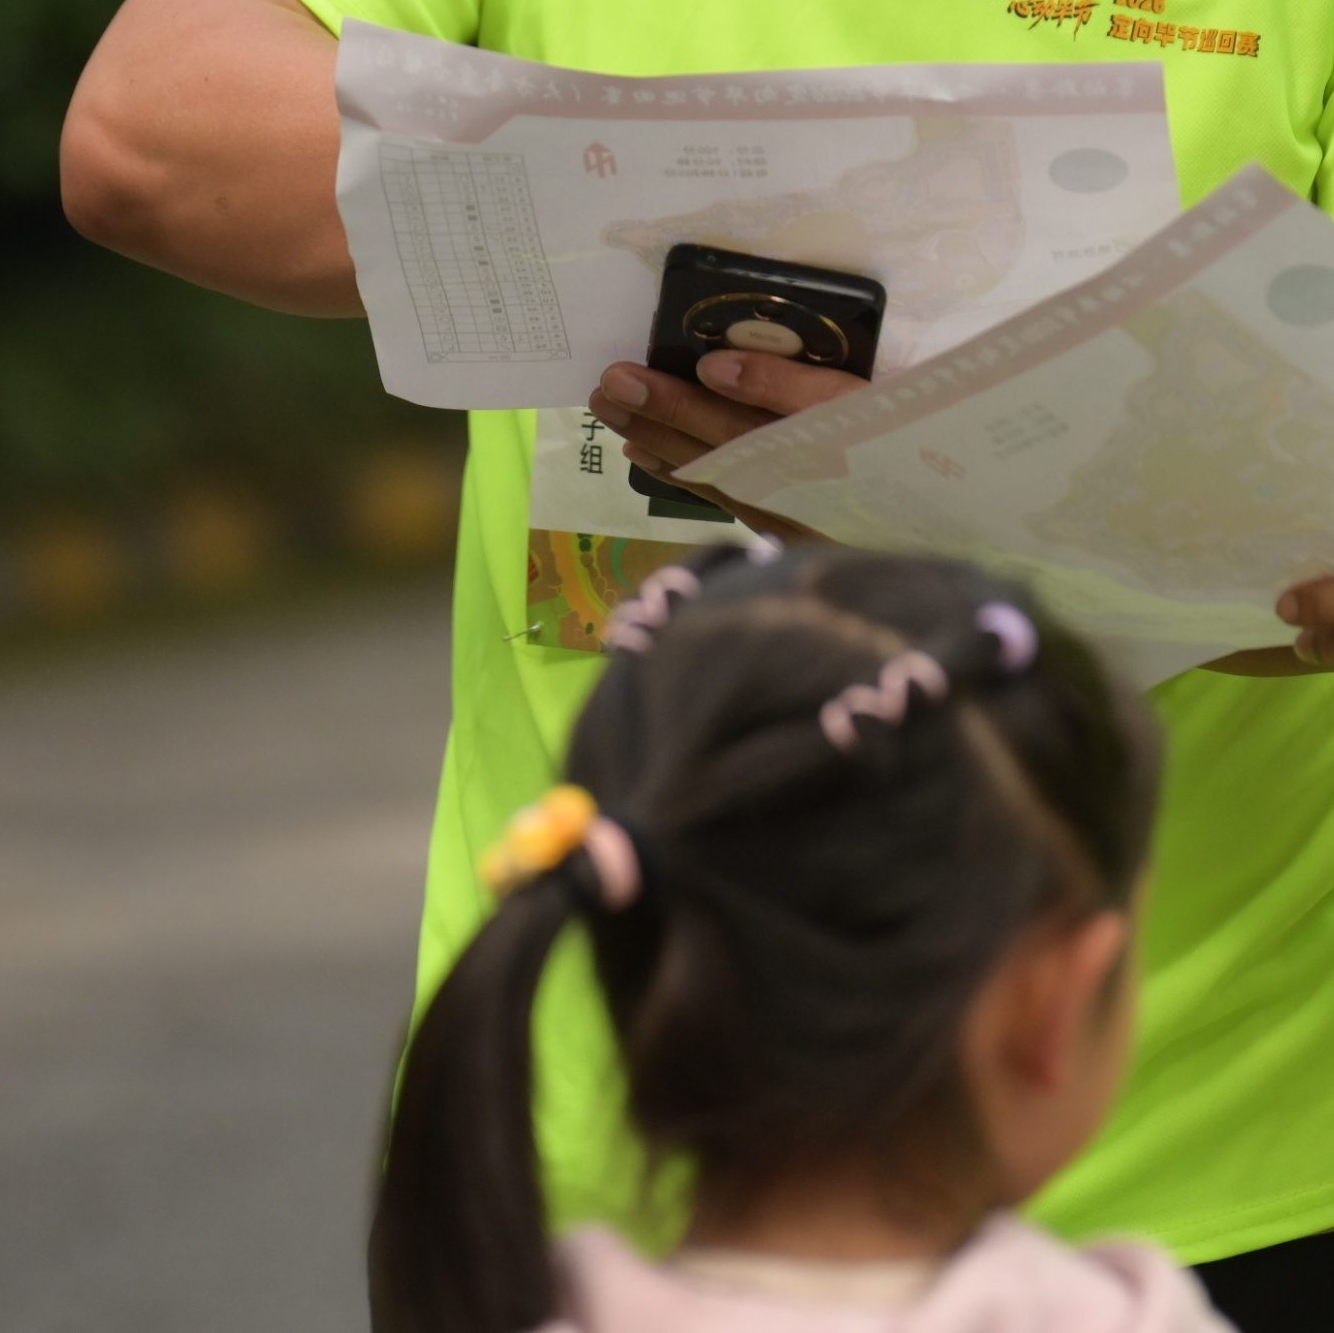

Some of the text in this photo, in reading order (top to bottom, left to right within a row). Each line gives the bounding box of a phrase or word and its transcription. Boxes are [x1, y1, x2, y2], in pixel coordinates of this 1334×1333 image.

[1107, 14, 1260, 57] 定向毕节巡回赛
[580, 412, 605, 474] 子组
